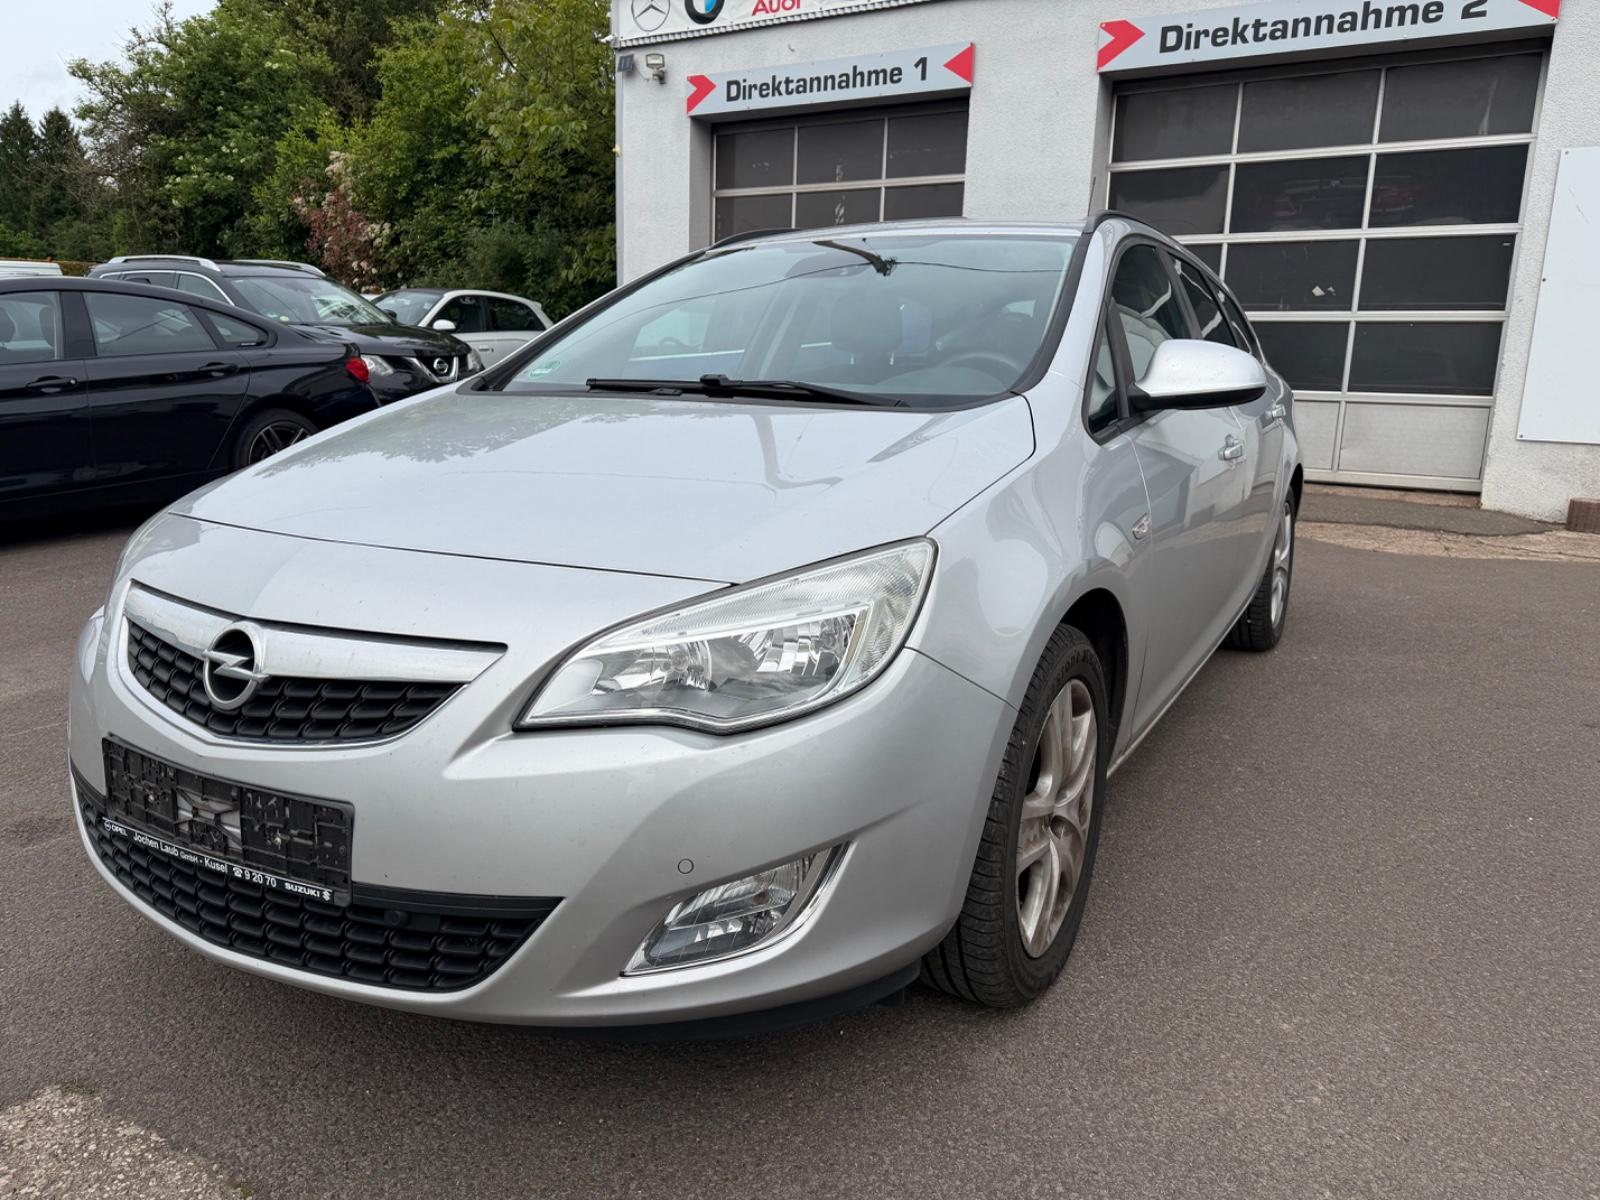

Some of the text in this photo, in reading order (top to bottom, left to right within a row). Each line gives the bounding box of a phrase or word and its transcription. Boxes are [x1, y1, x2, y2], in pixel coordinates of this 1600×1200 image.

[1158, 0, 1488, 54] Direktannahme 2
[726, 56, 928, 102] Direktannahme 1
[133, 832, 159, 850] Jochen
[160, 841, 179, 857] Laub
[204, 857, 228, 874] Kusel
[244, 870, 251, 880] 9
[252, 872, 263, 884] 20
[265, 875, 277, 888] 70
[284, 882, 320, 897] SUZUKI
